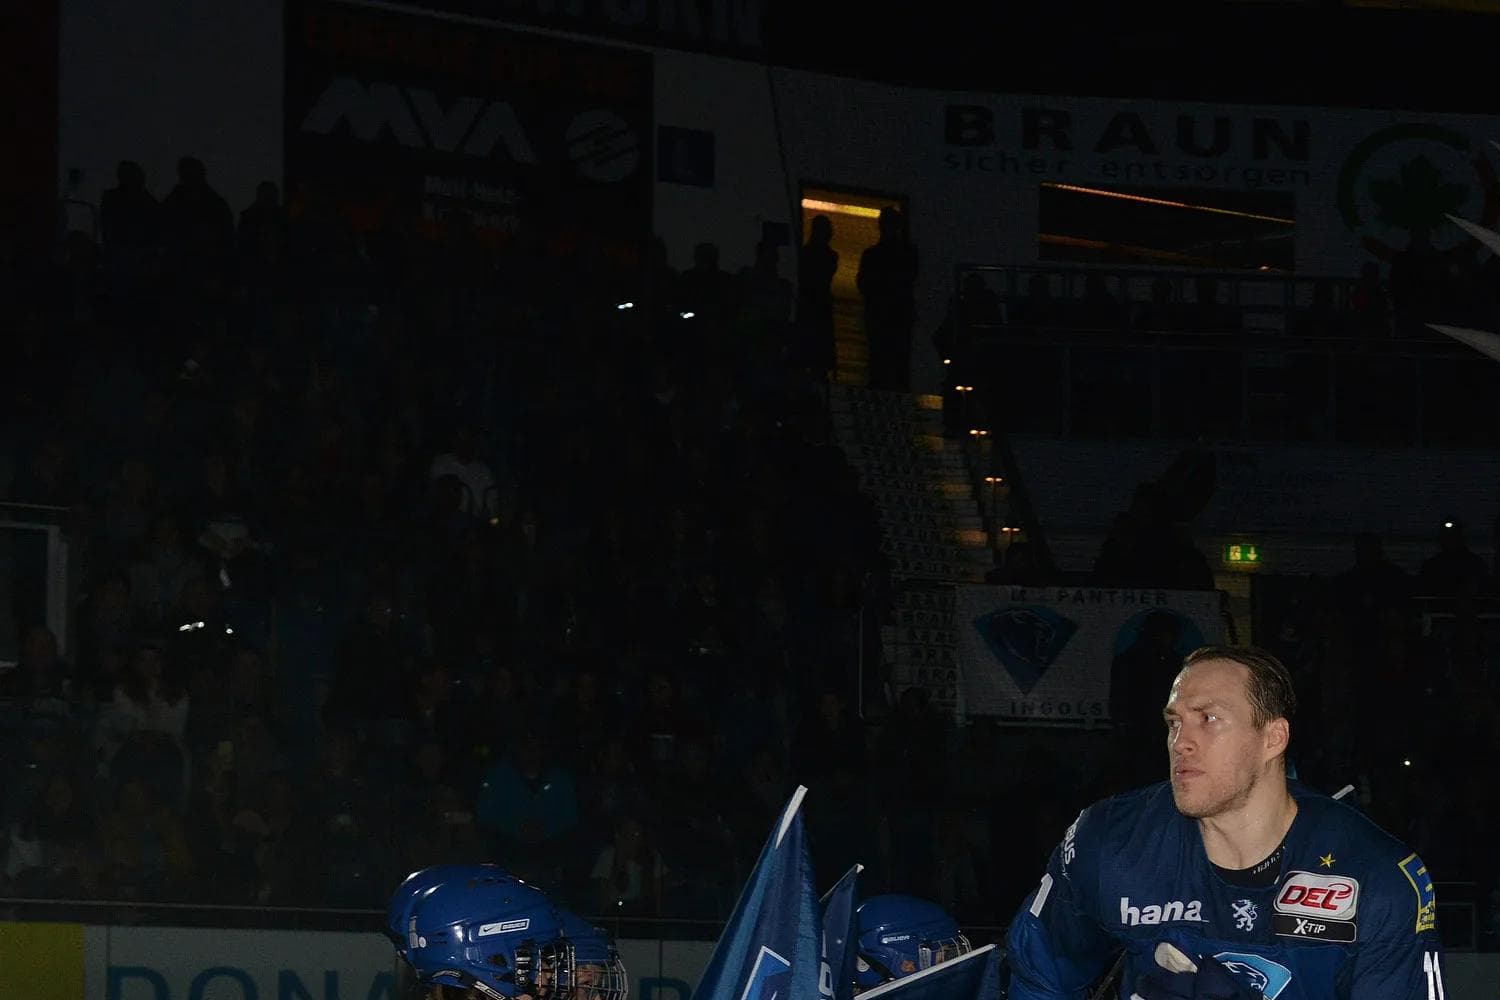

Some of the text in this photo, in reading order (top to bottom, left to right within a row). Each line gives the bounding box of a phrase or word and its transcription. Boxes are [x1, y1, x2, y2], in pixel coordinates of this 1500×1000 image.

[299, 74, 541, 165] MVA
[944, 104, 1312, 161] BRAUN
[943, 149, 1312, 187] sicher entsorgen
[1056, 589, 1170, 606] PANTHER
[1279, 883, 1355, 911] DEL
